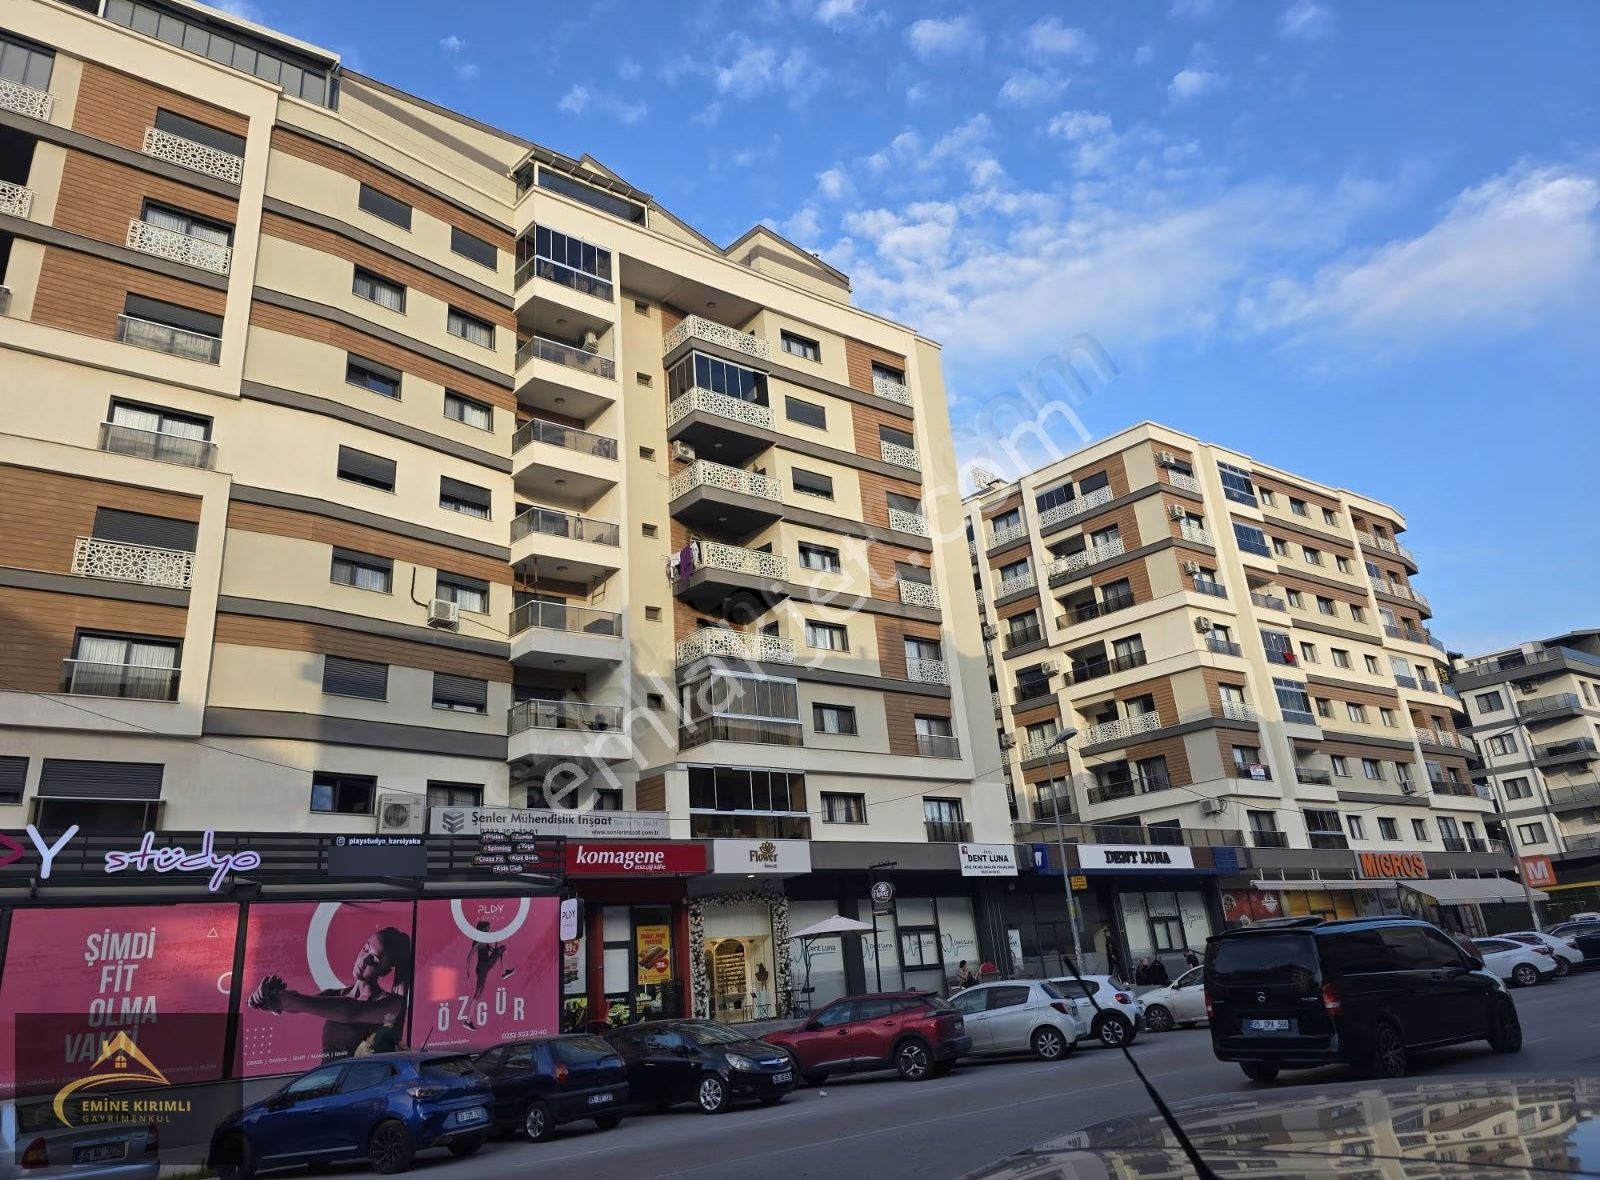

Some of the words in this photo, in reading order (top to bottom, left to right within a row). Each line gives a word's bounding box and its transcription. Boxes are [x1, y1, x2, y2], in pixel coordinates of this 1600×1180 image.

[471, 811, 508, 825] Şenler
[104, 829, 260, 891] stüdyo
[576, 846, 664, 870] komagene
[750, 850, 778, 862] Flower
[1104, 850, 1138, 864] DENT
[1140, 851, 1171, 864] LUNA
[1525, 860, 1550, 880] M
[84, 927, 156, 966] ŞİMDİ
[100, 961, 138, 994] FİT
[88, 996, 157, 1028] OLMA
[438, 988, 525, 1032] ÖZGÜR
